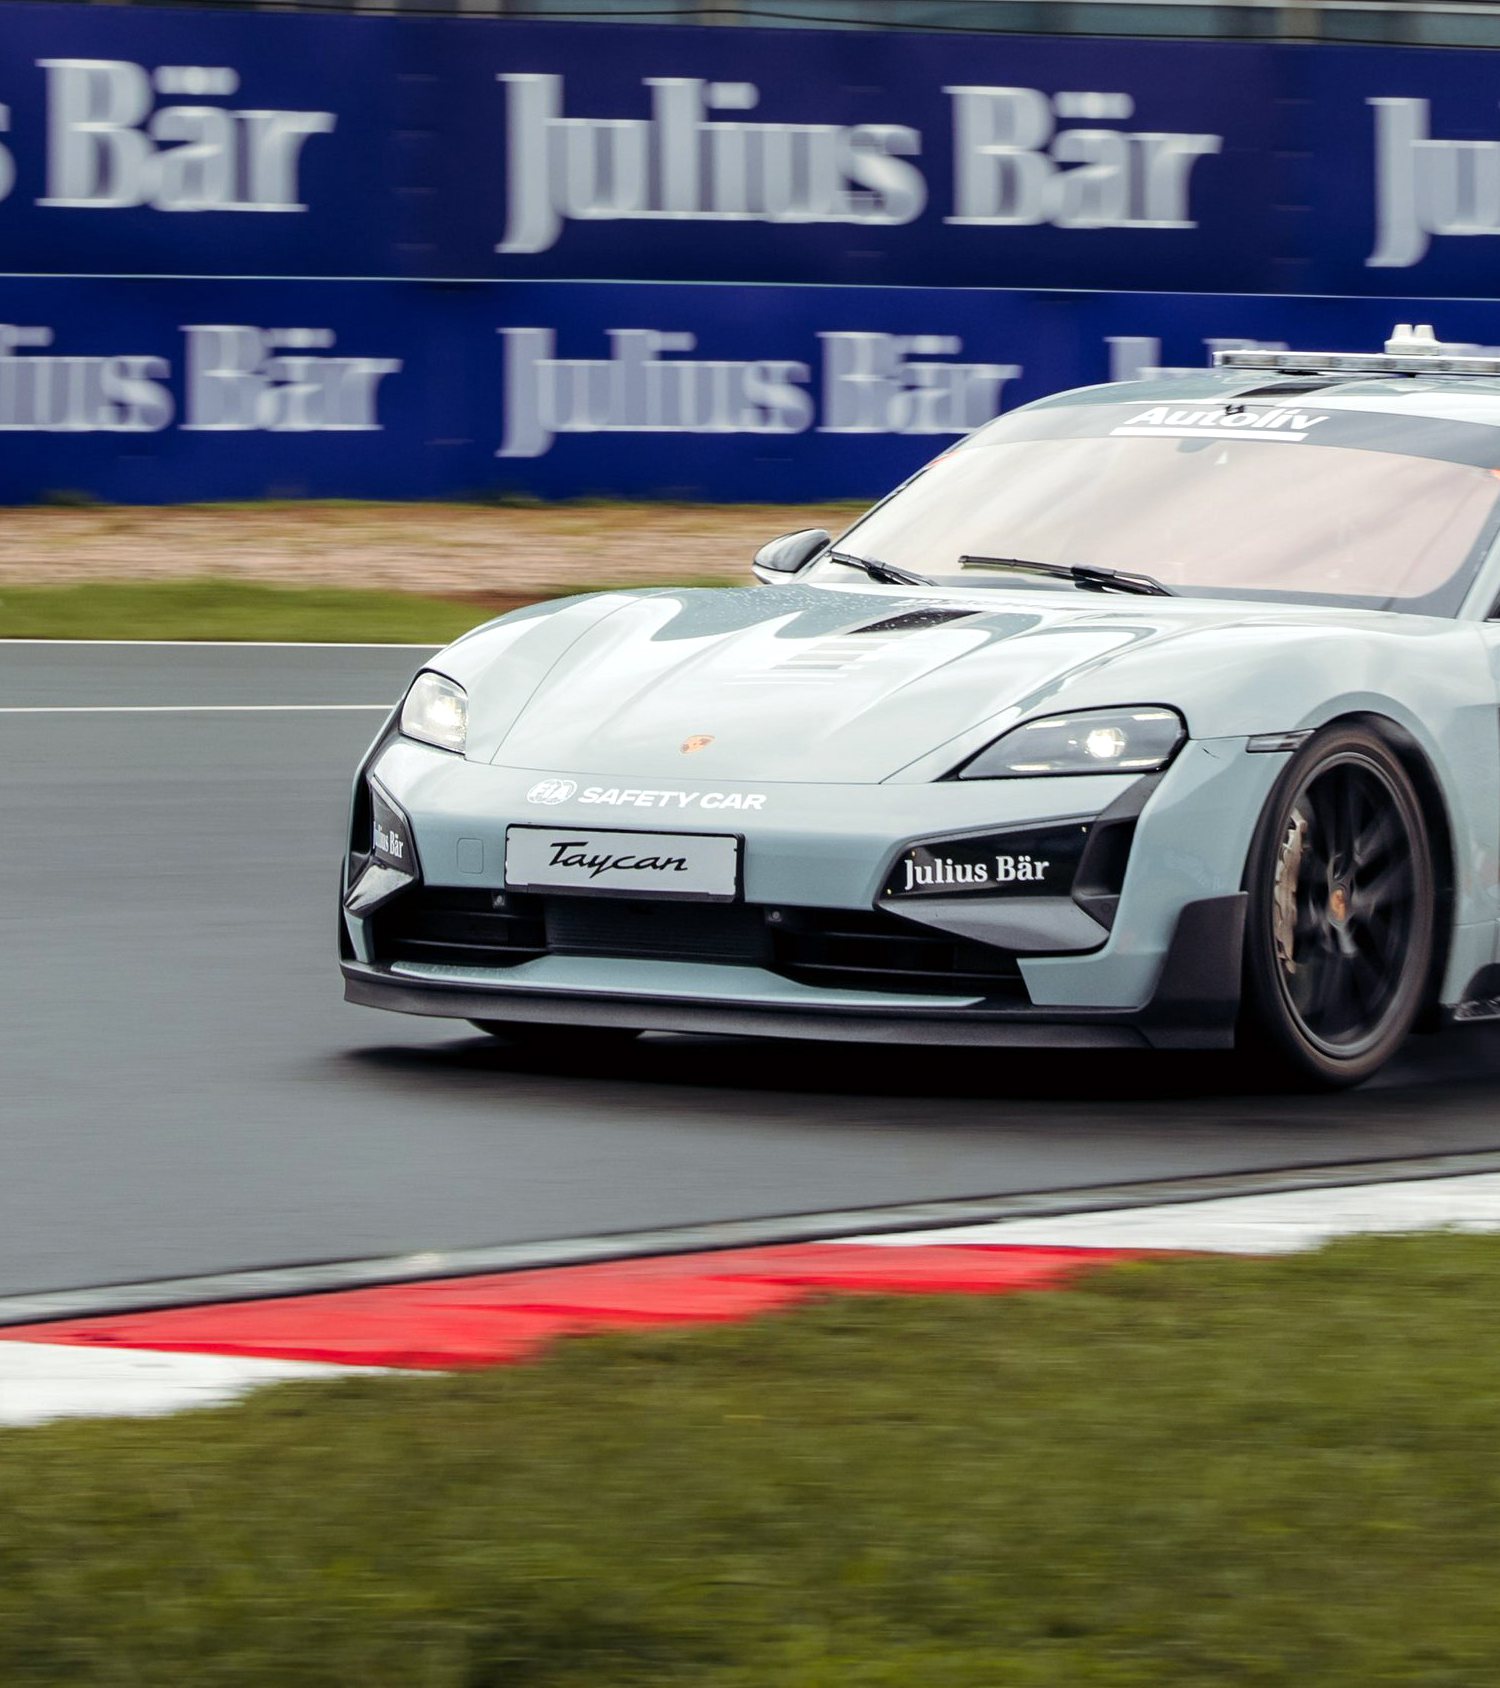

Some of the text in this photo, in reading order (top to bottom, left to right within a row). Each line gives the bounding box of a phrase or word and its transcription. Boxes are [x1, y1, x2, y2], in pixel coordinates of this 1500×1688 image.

[34, 57, 336, 214] Bär
[495, 71, 1223, 255] Julius Bär
[178, 323, 404, 434] Bär
[495, 326, 815, 459] Julius
[815, 330, 1024, 435] Bär
[1122, 406, 1330, 430] Autoliv
[527, 780, 768, 811] FIA SAFETY CAR
[547, 841, 690, 879] Taycan
[903, 854, 1050, 891] Julius Bär
